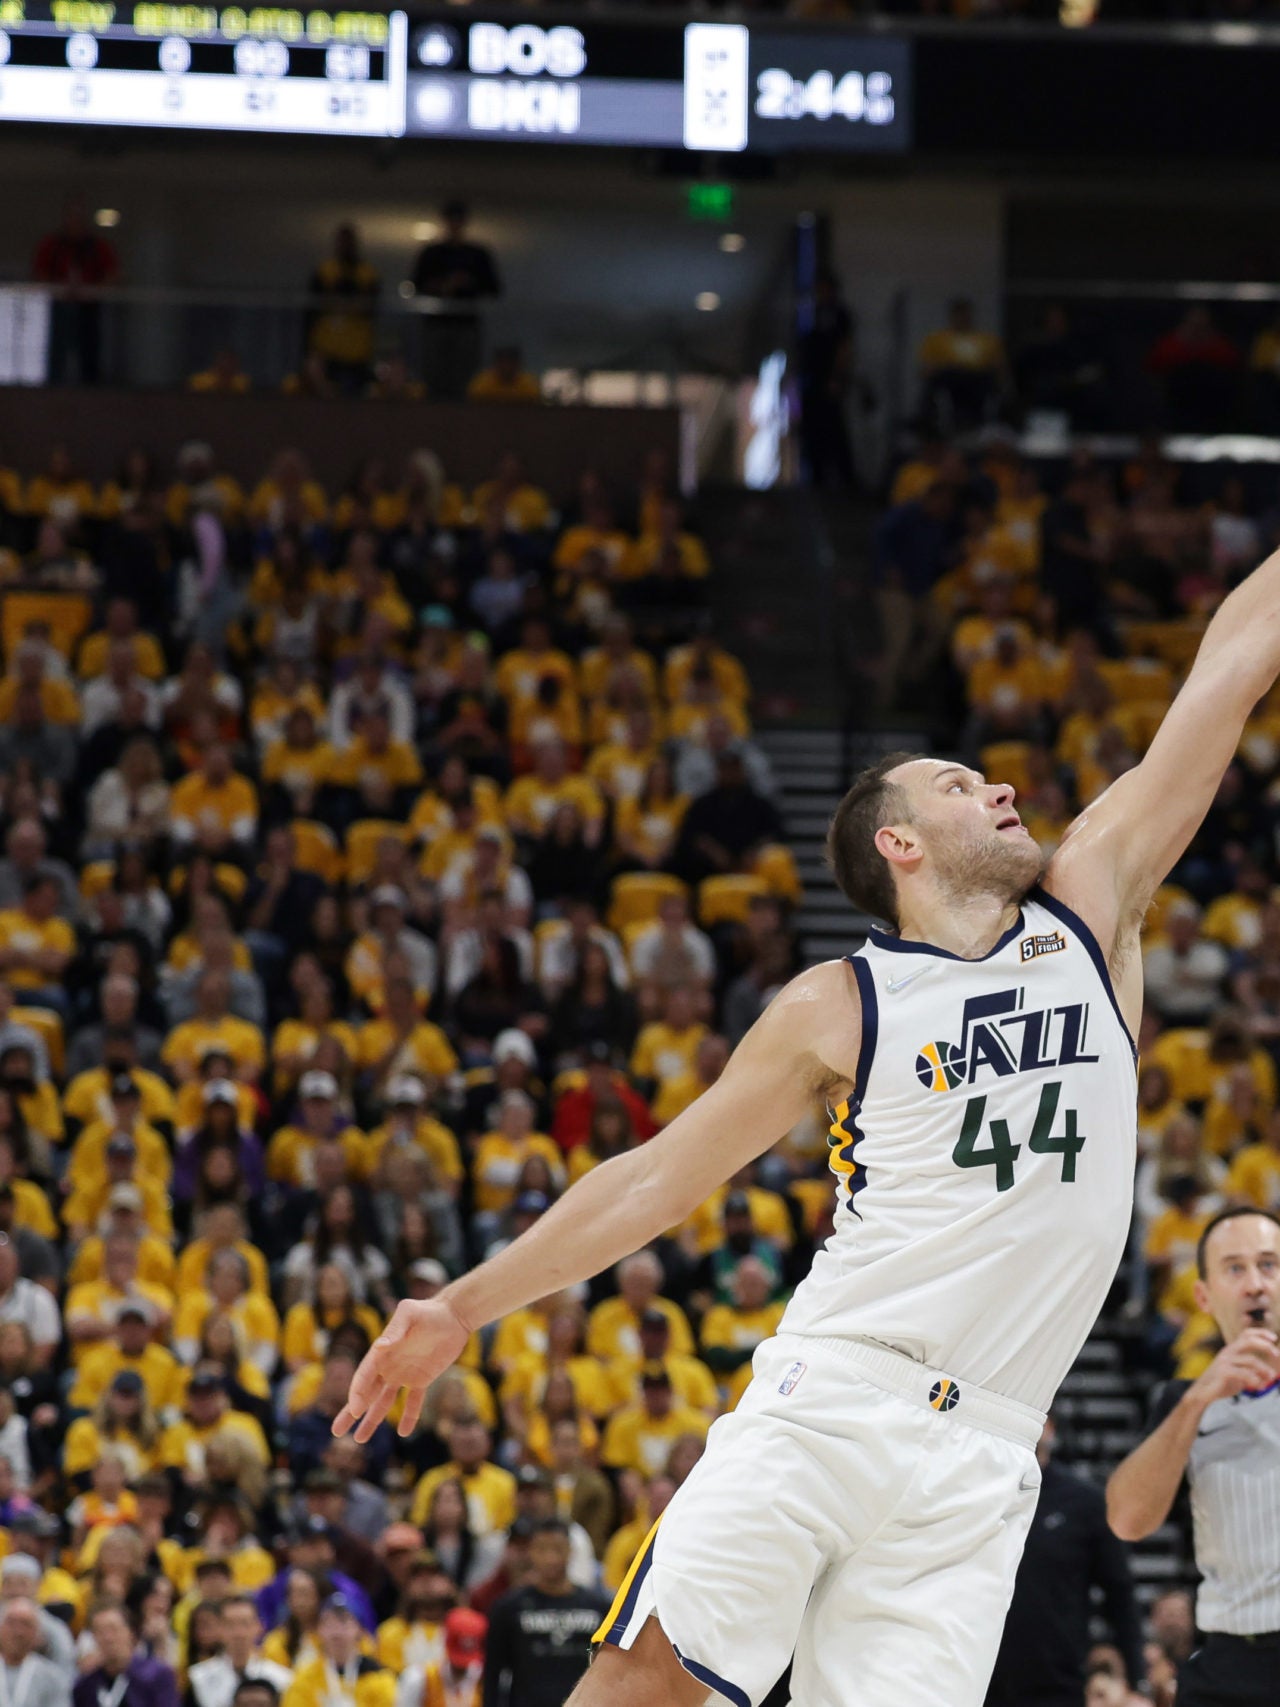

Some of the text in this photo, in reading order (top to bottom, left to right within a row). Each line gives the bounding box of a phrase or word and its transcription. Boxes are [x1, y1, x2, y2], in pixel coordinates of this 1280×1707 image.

[468, 22, 587, 77] BOS
[1022, 938, 1034, 960] 5
[1037, 940, 1064, 954] FIGHT
[916, 987, 1100, 1092] JAZZ
[952, 1081, 1086, 1193] 44
